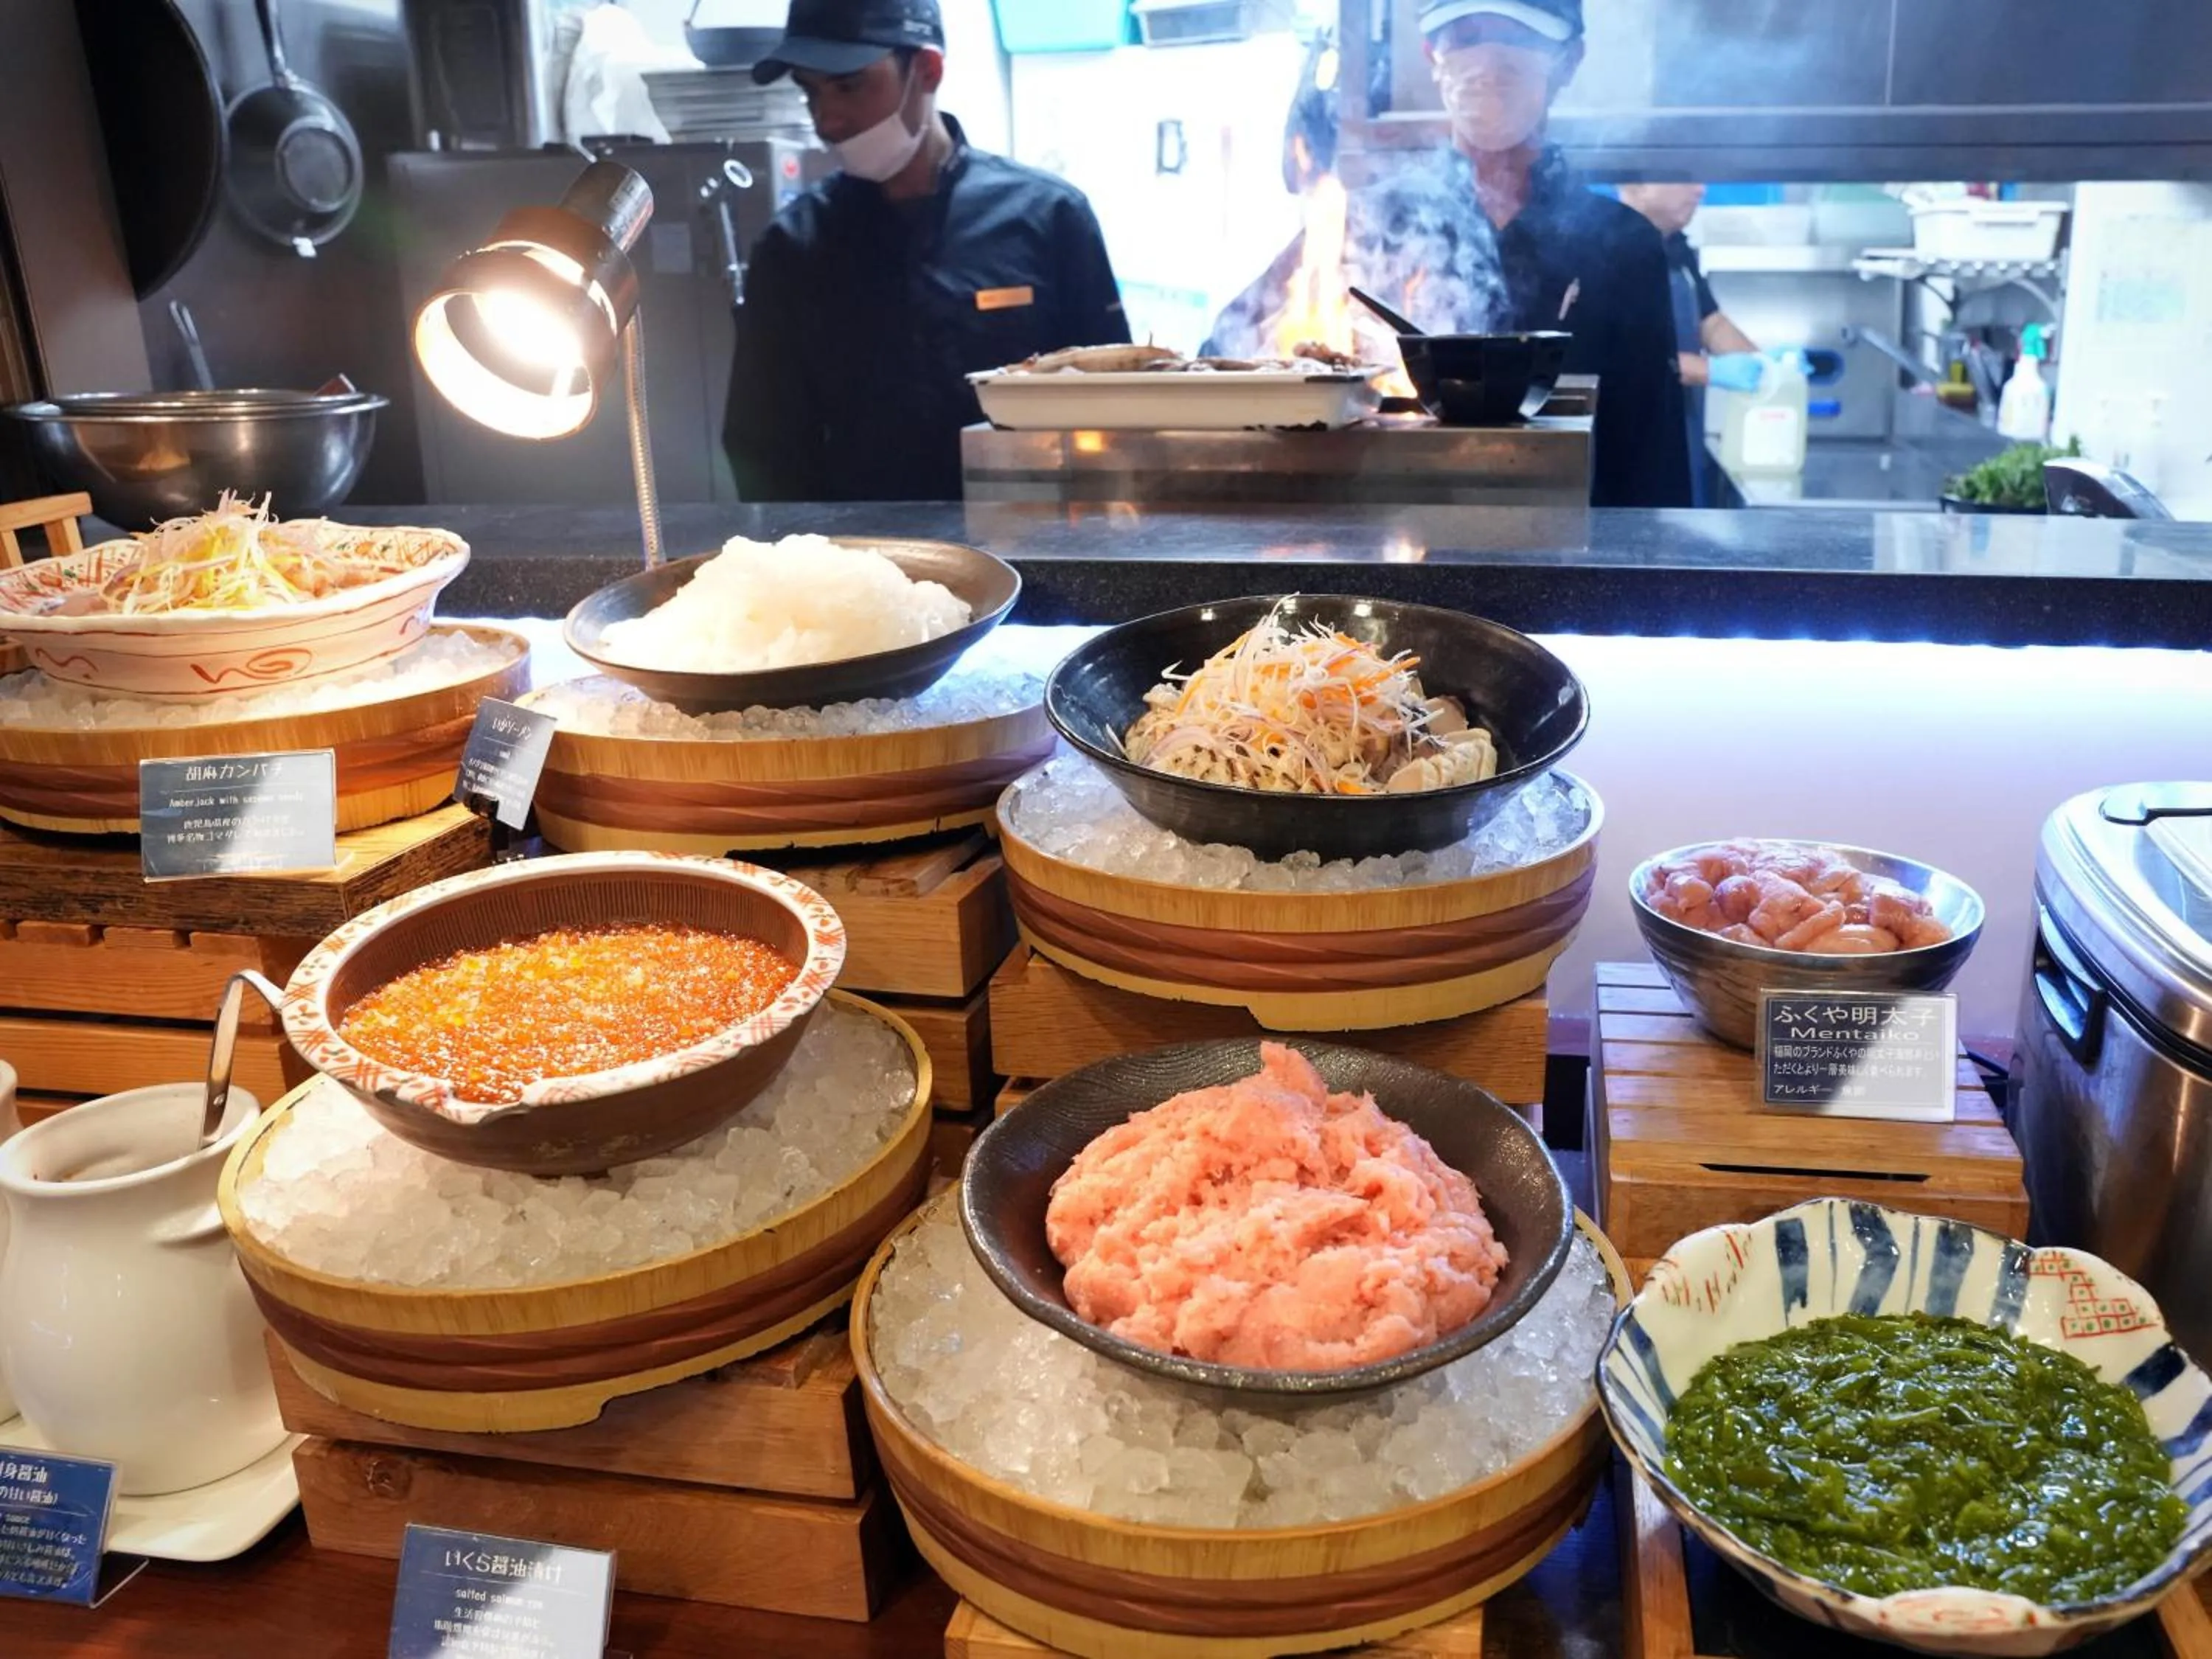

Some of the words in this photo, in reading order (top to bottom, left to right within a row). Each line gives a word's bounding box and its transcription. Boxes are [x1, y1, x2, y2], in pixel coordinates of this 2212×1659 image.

[1774, 1005, 1937, 1026] ふくや明太子
[1790, 1027, 1919, 1041] Mentaiko
[1773, 1084, 1834, 1096] アレルギー
[445, 1550, 562, 1584] いくら醤油漬け
[456, 1588, 486, 1601] salted
